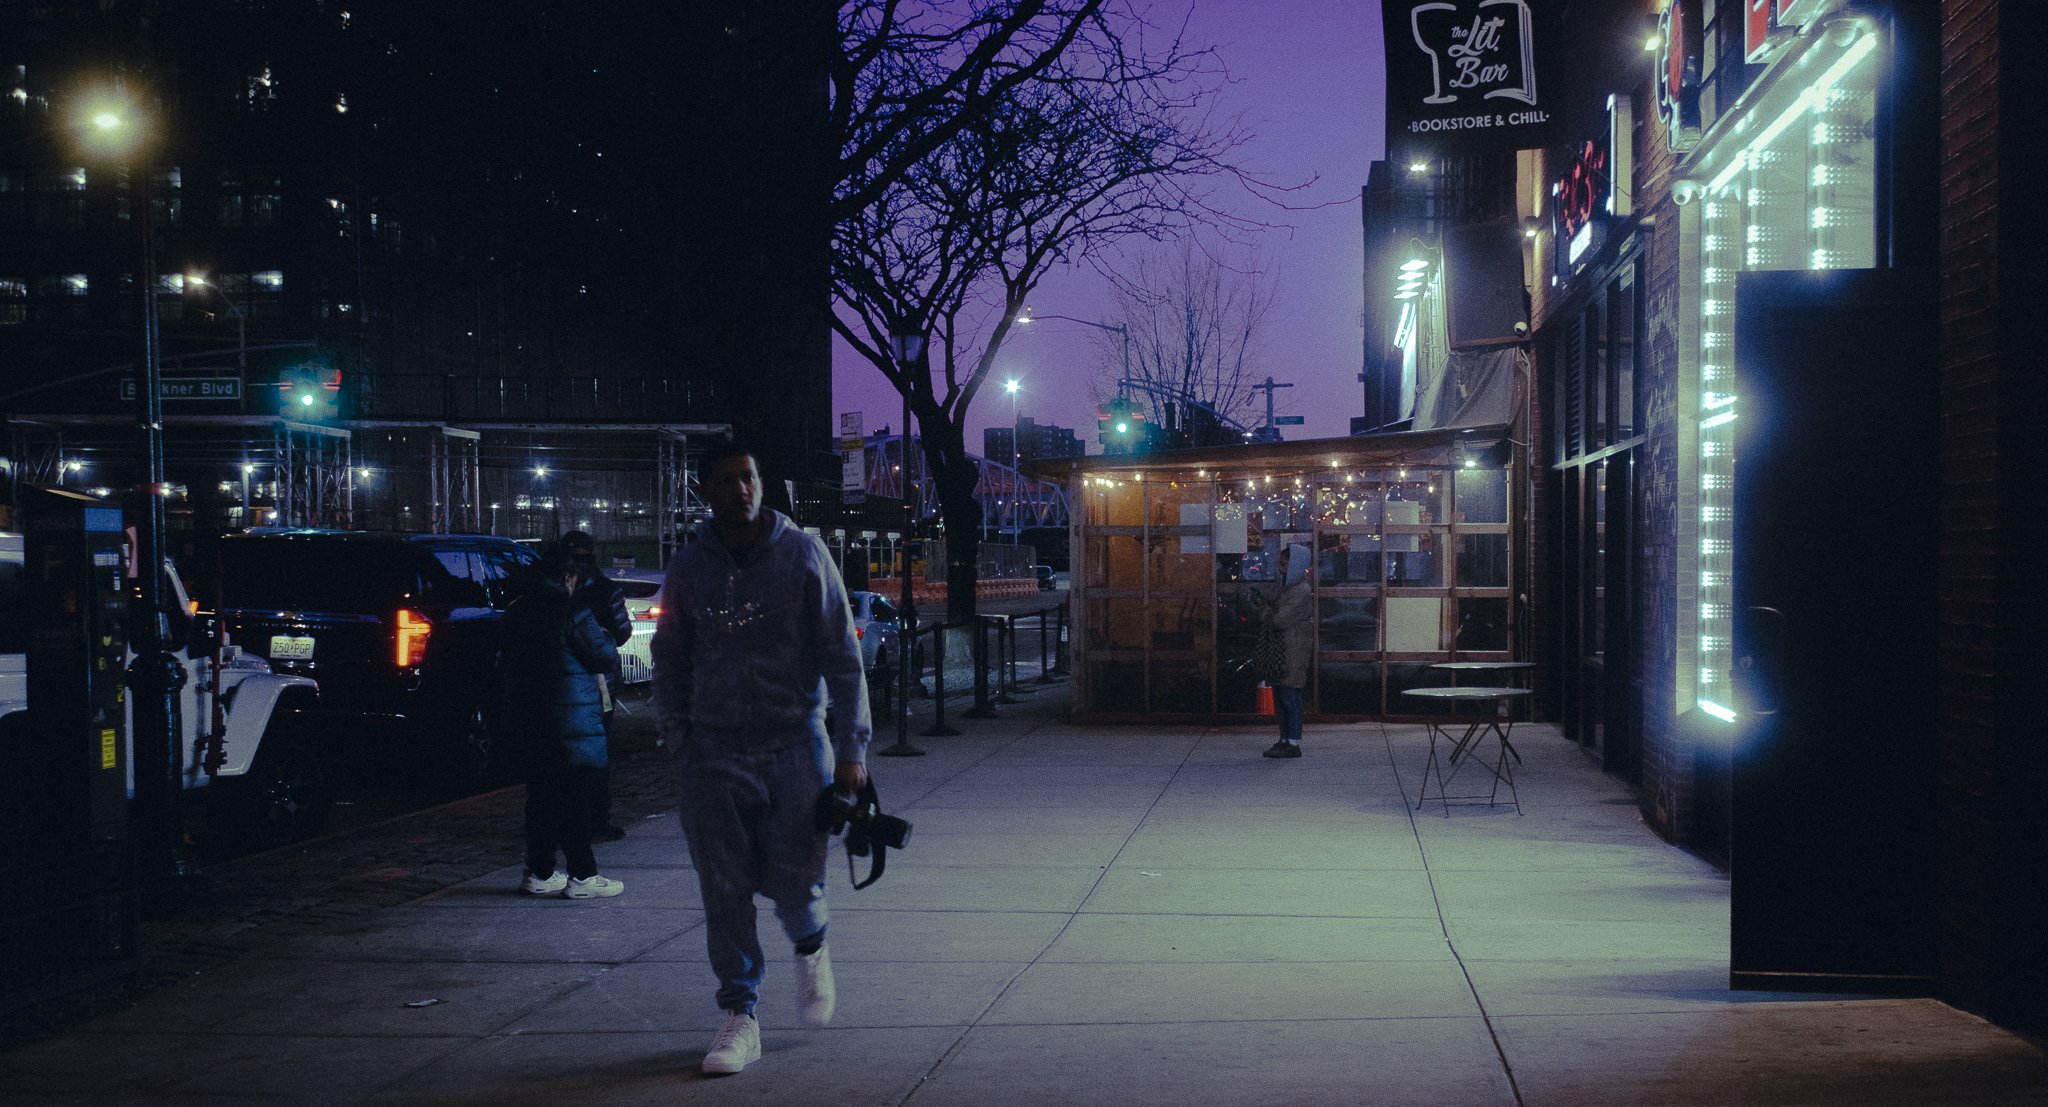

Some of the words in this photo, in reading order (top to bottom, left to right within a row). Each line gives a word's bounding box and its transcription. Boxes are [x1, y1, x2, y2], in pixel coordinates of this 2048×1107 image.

[1452, 26, 1469, 39] the
[1449, 56, 1509, 88] Bar
[1496, 114, 1506, 126] &
[201, 382, 233, 394] Blvd
